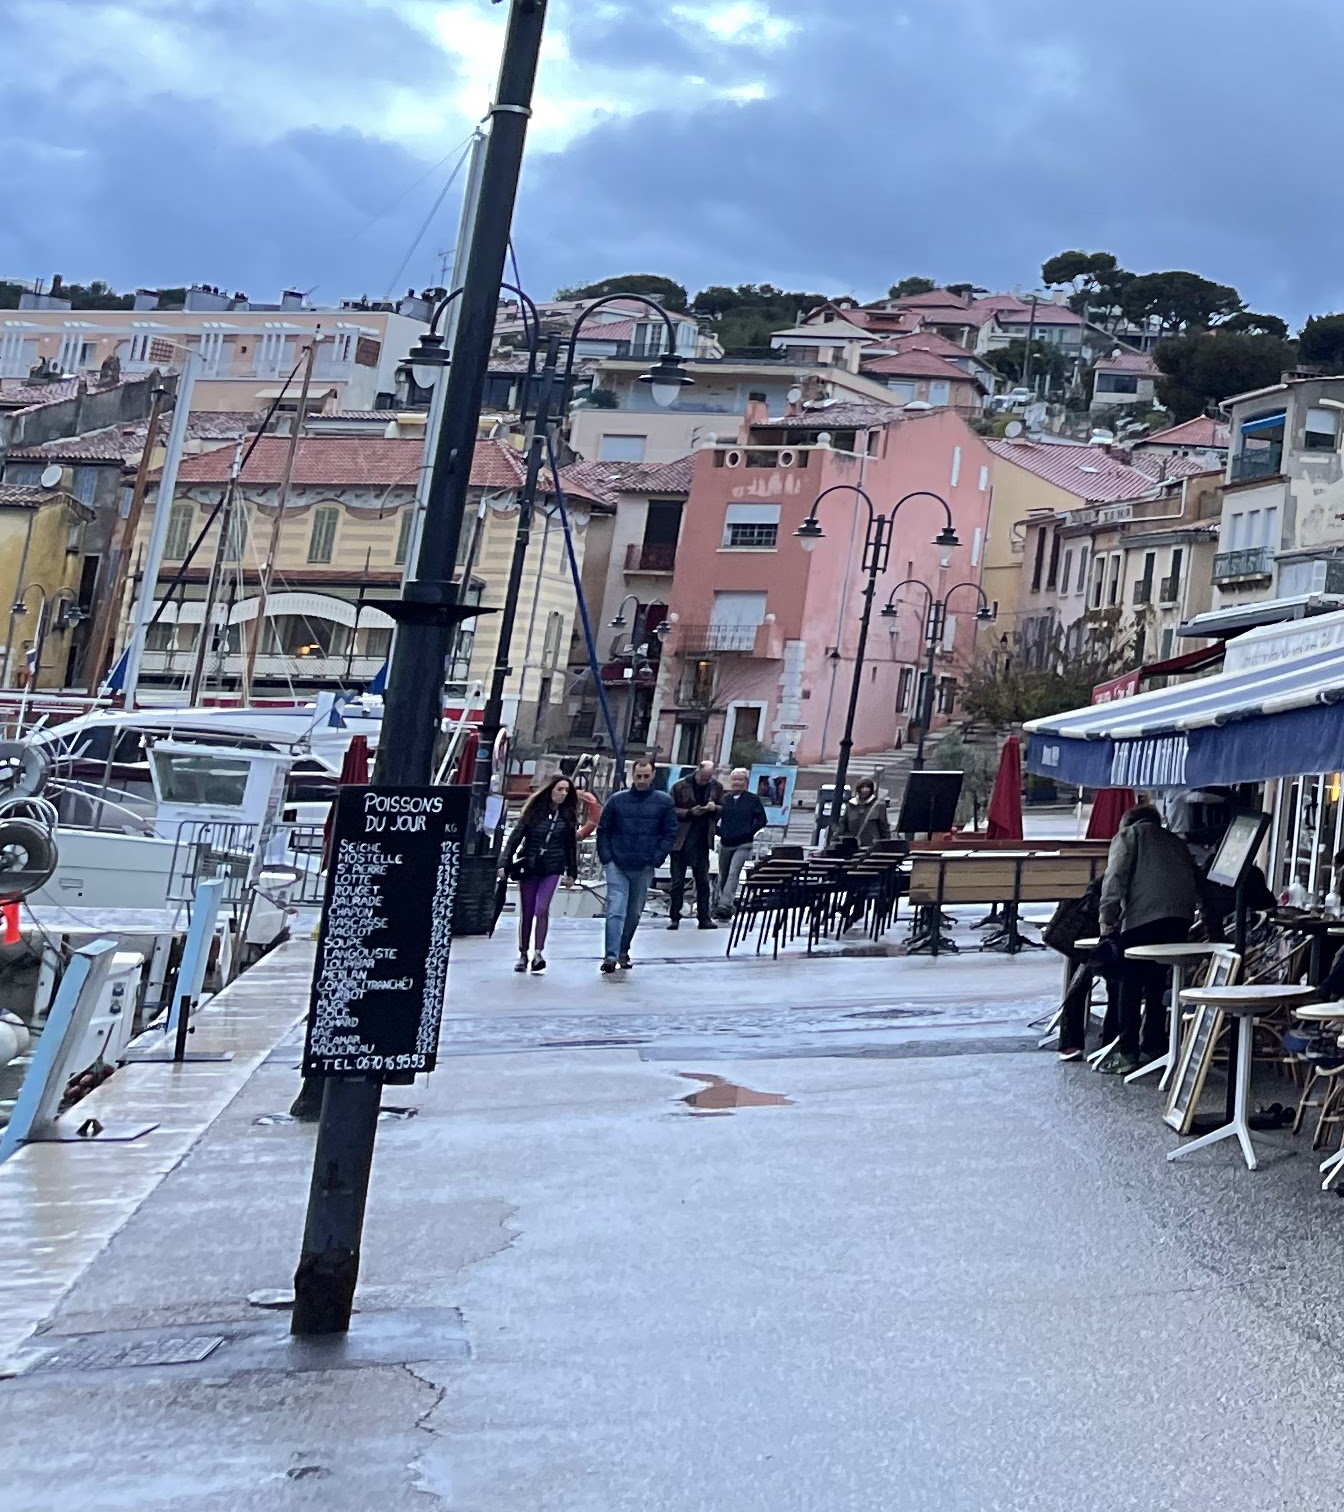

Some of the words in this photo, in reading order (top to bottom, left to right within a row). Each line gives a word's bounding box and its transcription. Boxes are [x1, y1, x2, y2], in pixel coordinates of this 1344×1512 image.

[363, 792, 444, 813] POISSONS
[364, 815, 387, 833] DU
[390, 815, 426, 833] JOUR
[334, 874, 373, 885] LOTTE
[334, 885, 381, 896] ROUGET
[332, 895, 385, 906] DAURADE
[328, 906, 374, 917] CHAPON
[328, 917, 389, 929] RASCASSE
[323, 937, 363, 949] SOUPE
[323, 947, 398, 959] LANGOUSTE
[321, 969, 368, 980] MERLAN
[310, 1035, 361, 1045] CALAMAR
[310, 1043, 376, 1056] MAQUEREAU
